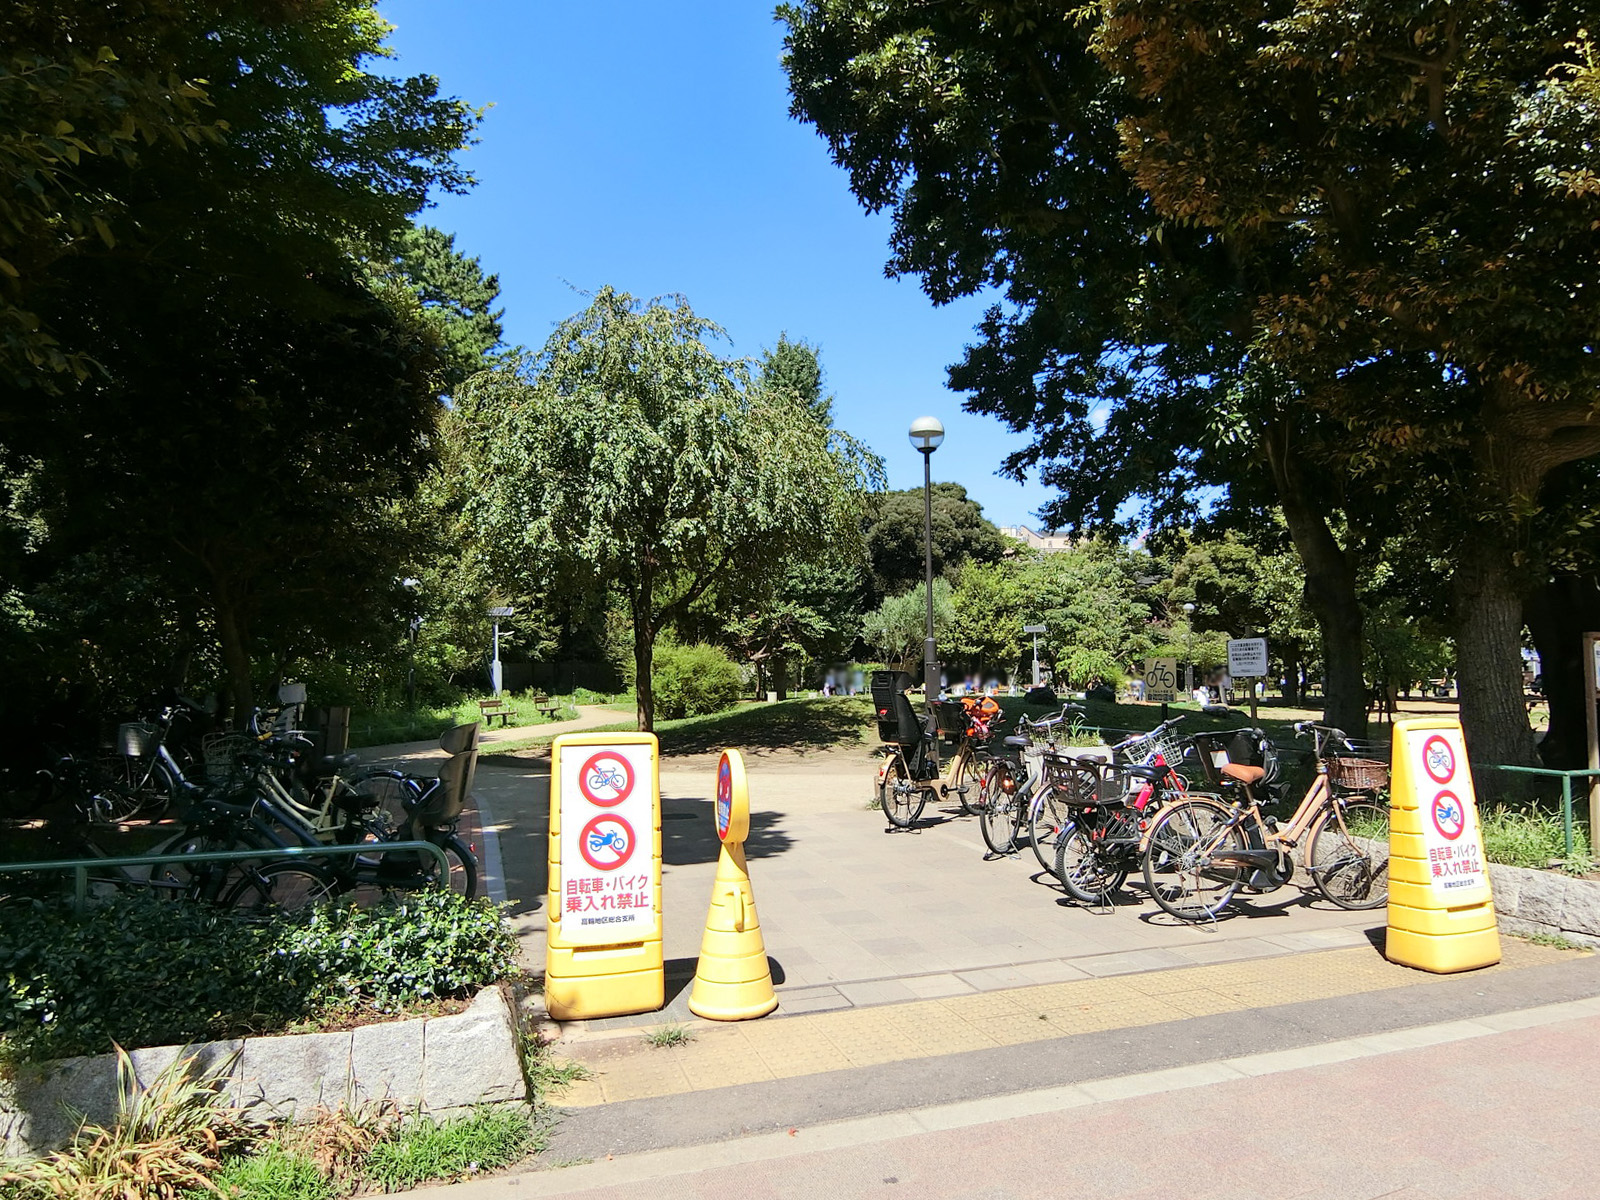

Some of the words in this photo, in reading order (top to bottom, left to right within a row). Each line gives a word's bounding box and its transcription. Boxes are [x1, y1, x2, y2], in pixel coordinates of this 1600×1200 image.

[1429, 844, 1477, 862] 自転車・バイク
[1432, 859, 1480, 878] 乗入れ禁止
[566, 874, 648, 895] 自転車・バイク
[566, 892, 649, 913] 乗入れ禁止
